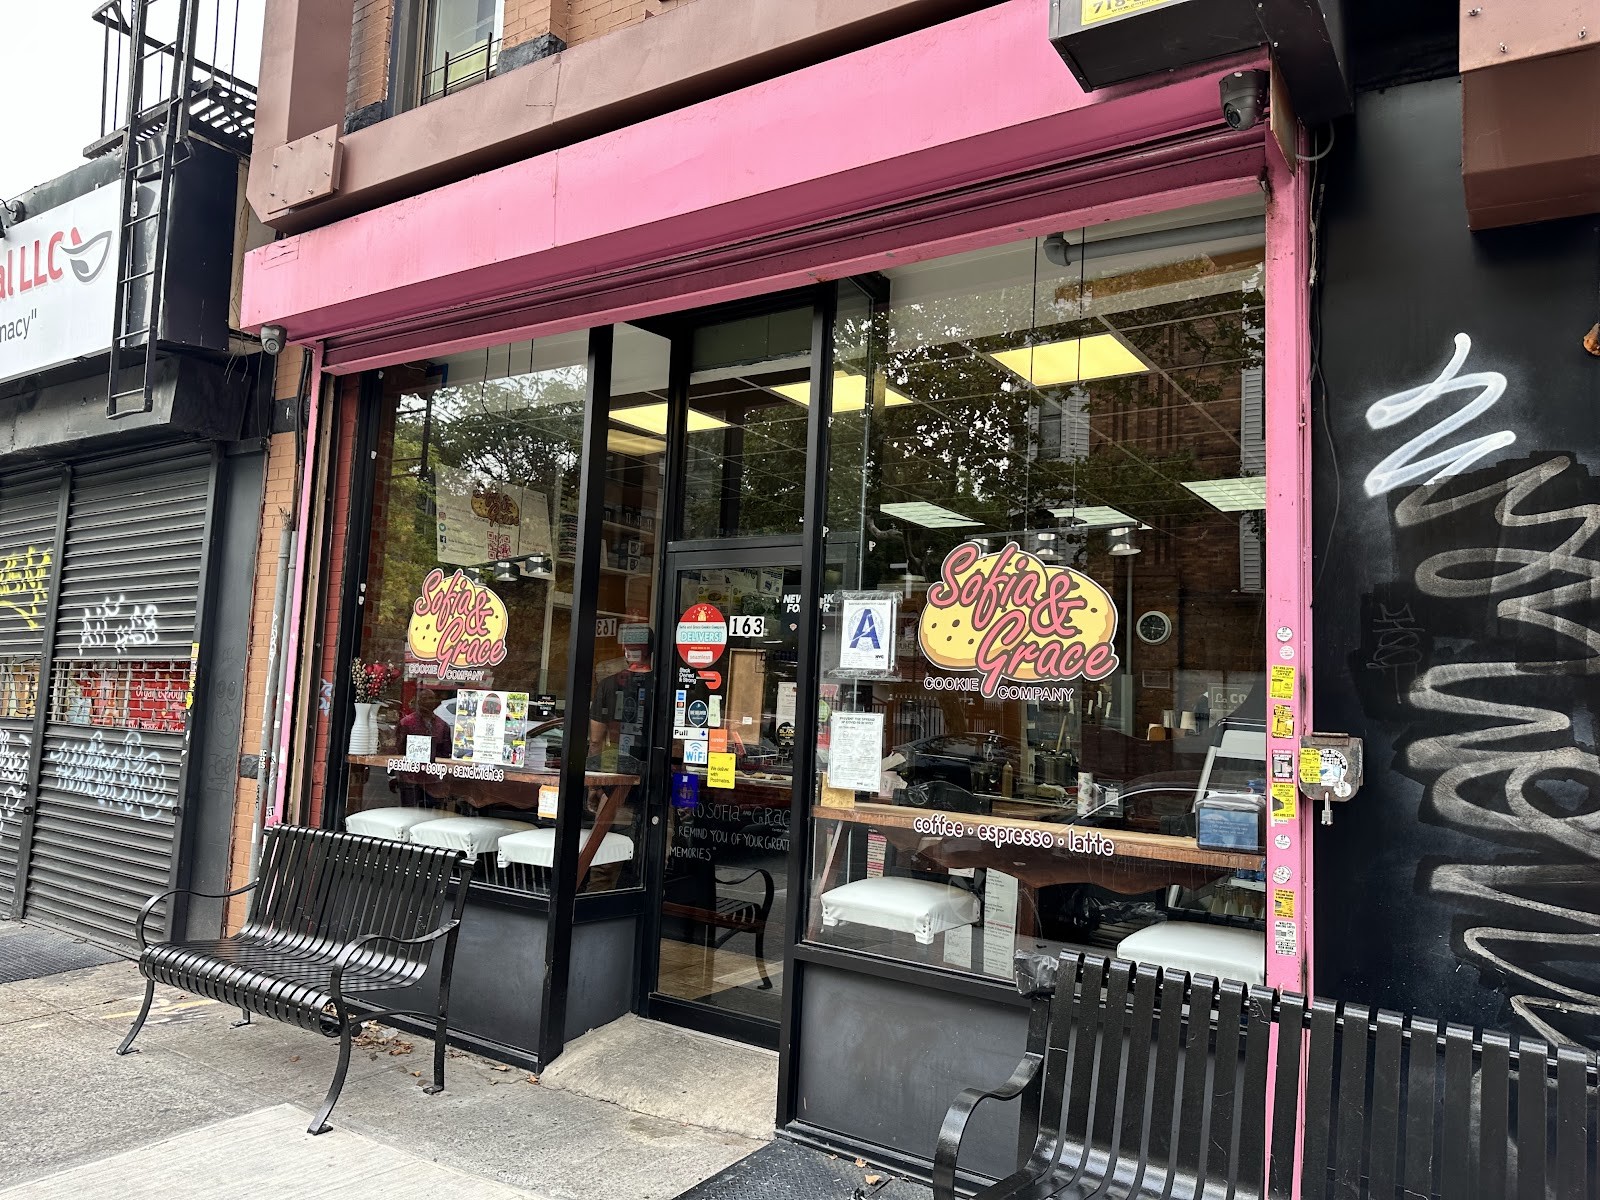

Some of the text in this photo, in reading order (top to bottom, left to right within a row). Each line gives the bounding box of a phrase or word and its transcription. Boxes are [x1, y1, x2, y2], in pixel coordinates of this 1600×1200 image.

[20, 231, 64, 292] LLC
[415, 570, 494, 635] Sofia &
[930, 543, 1088, 636] Sofia &
[680, 632, 722, 642] DELIVERS!
[732, 618, 764, 635] 163
[849, 609, 881, 649] A
[437, 622, 506, 677] Grace
[976, 610, 1117, 696] Grace
[409, 664, 484, 682] COOKIE COMPANY
[924, 677, 1074, 702] COOKIE COMPANY
[387, 757, 504, 782] pastries soup sandwiches
[685, 752, 706, 762] WiFi
[678, 826, 708, 840] REMIND
[710, 829, 728, 843] YOU
[731, 833, 743, 845] OF
[742, 833, 764, 849] YOUR
[914, 814, 1114, 855] coffee espresso latte
